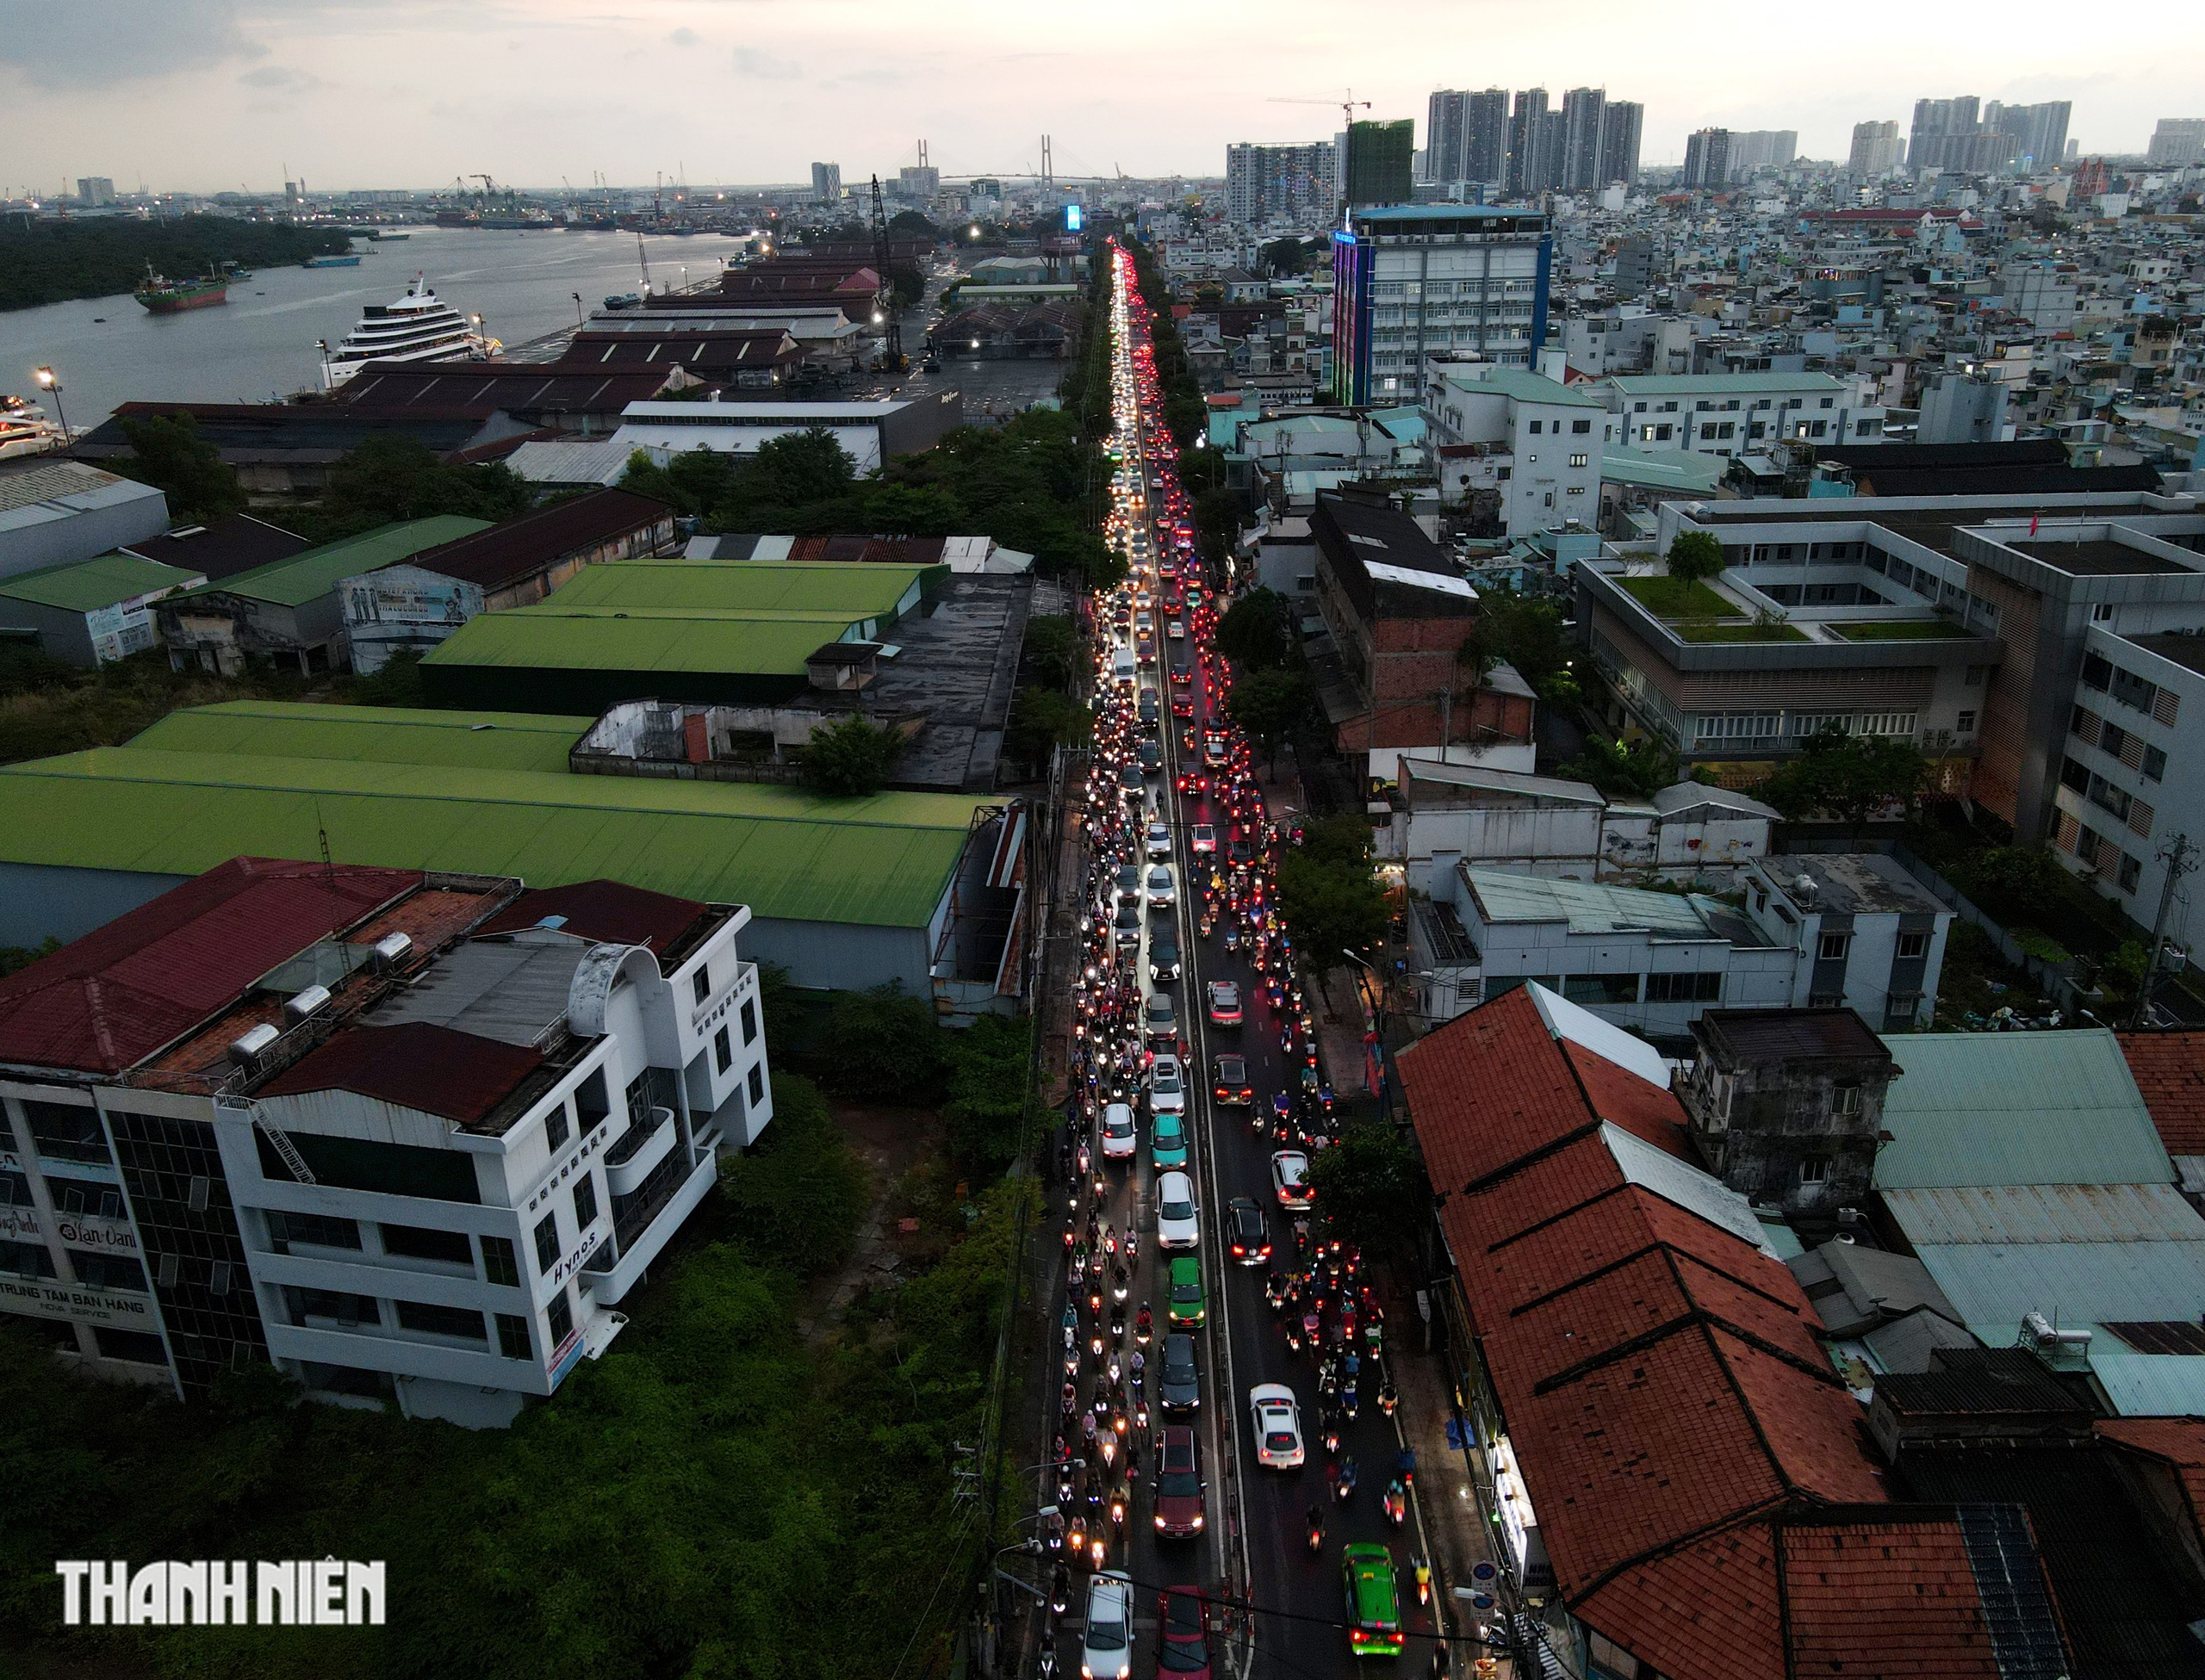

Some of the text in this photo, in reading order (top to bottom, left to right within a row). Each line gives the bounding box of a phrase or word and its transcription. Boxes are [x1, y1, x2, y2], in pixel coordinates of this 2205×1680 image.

[554, 1231, 595, 1286] Hynos
[42, 1289, 71, 1304] TAM
[71, 1293, 102, 1308] BAN
[105, 1299, 145, 1314] HANG
[70, 1307, 111, 1319] SERVICE
